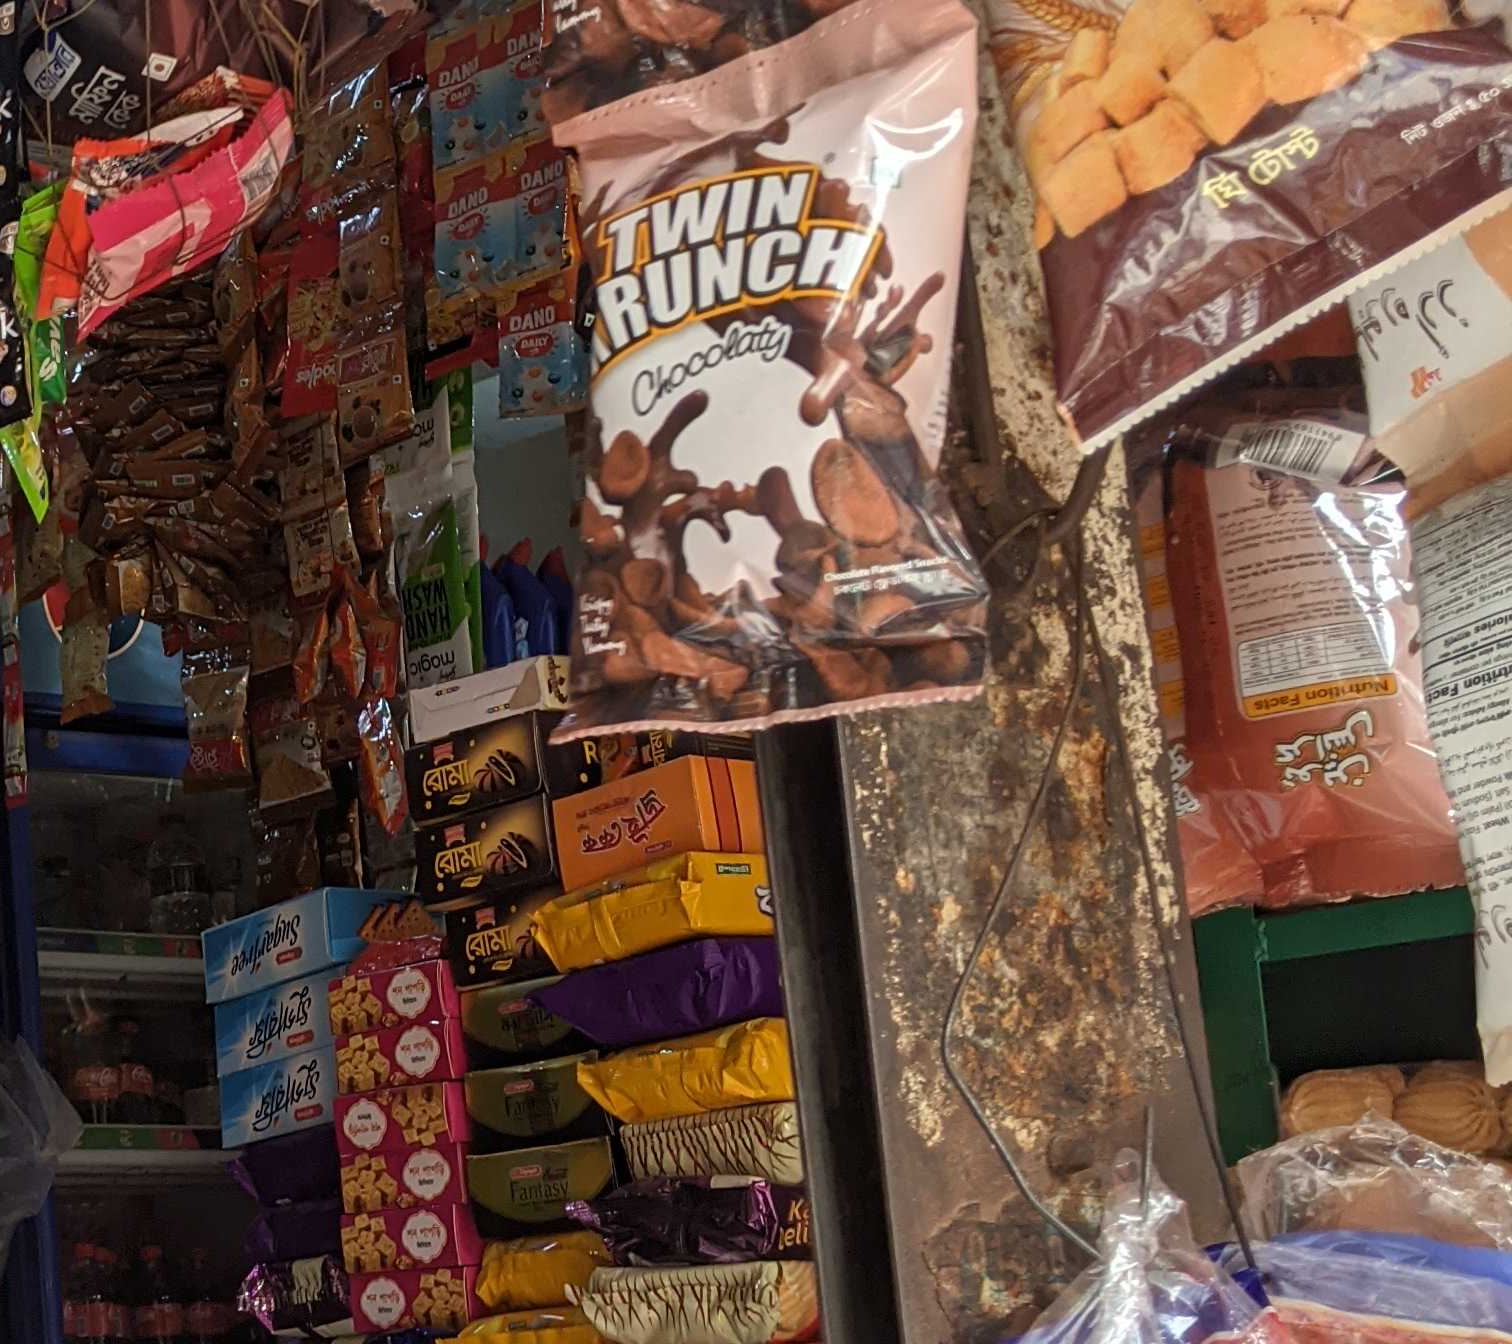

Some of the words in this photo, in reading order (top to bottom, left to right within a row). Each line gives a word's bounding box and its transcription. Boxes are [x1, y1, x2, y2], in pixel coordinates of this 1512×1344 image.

[507, 31, 543, 56] DAN
[438, 58, 480, 87] DANO
[104, 88, 141, 129] কেক
[1248, 124, 1320, 186] টোস্ট
[521, 160, 564, 189] DANO
[447, 187, 487, 218] DANO
[607, 170, 814, 272] TWIN
[510, 305, 556, 331] DANO
[521, 336, 547, 349] DAILY
[631, 318, 789, 415] Chocolaty
[402, 578, 449, 610] WASH
[405, 606, 451, 637] HAND
[409, 649, 455, 678] magic
[1464, 666, 1512, 689] utrition
[1253, 692, 1301, 712] Facts
[1305, 679, 1389, 703] Nutrition
[423, 759, 471, 796] রোমা
[581, 821, 622, 853] কেক
[435, 841, 482, 878] রোমা
[466, 925, 512, 961] রোমা
[510, 1179, 569, 1203] Fantasy
